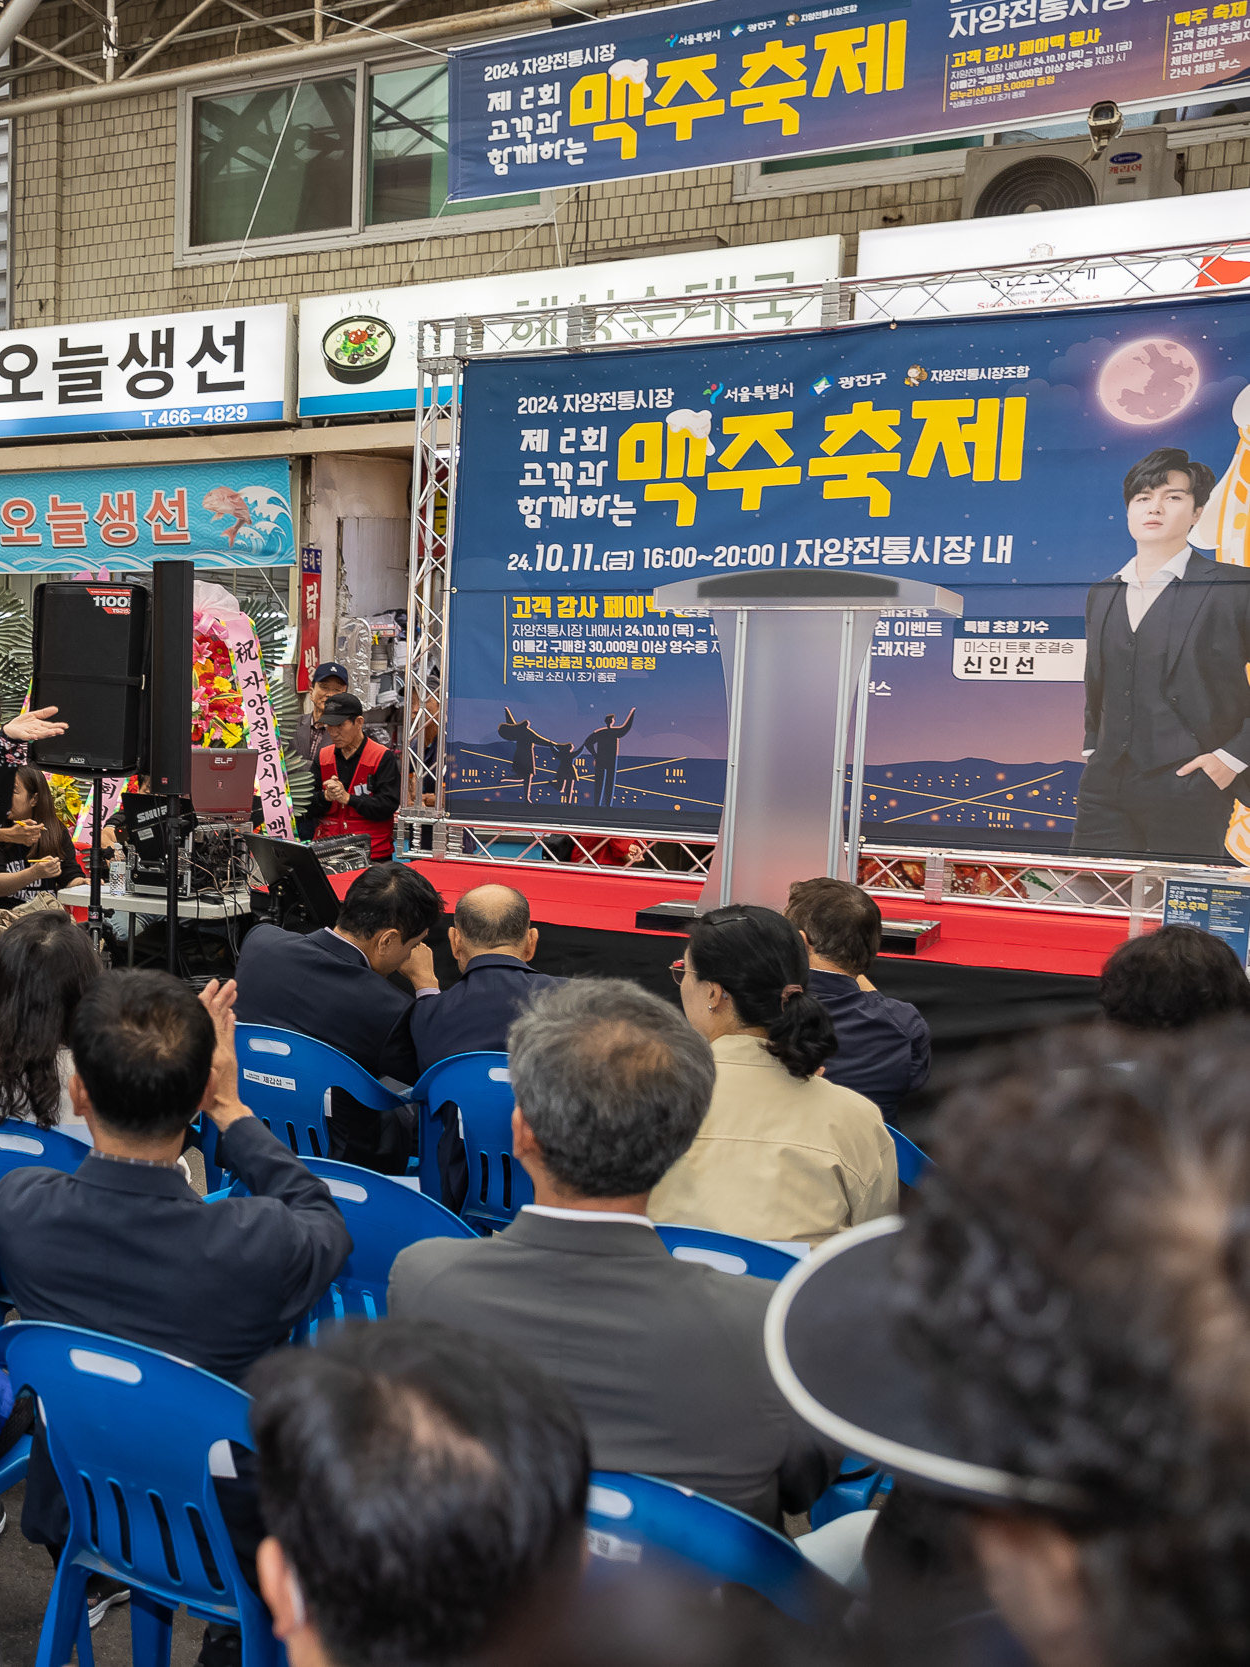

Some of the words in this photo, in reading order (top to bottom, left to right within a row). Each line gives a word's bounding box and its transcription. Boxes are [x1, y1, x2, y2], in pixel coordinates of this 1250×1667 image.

[800, 4, 857, 22] 자양전통시장조합
[1174, 8, 1208, 27] 맥주
[1213, 0, 1248, 19] 축제
[678, 29, 721, 45] 서울특별시
[747, 20, 776, 32] 광진구
[951, 49, 981, 68] 고객
[984, 43, 1016, 62] 감사
[1018, 34, 1066, 57] 페이백
[1069, 27, 1102, 47] 행사
[484, 61, 519, 81] 2024
[522, 43, 616, 75] 자양전통시장
[1170, 66, 1192, 79] 간식
[1194, 62, 1216, 75] 체험
[1218, 58, 1241, 70] 부스
[487, 90, 512, 112] 제
[520, 82, 561, 110] 2회
[488, 110, 562, 143] 고객과
[487, 137, 587, 176] 함께하는
[837, 373, 888, 389] 광진구
[930, 365, 1030, 382] 자양전통시장조합
[517, 395, 558, 414] 2024
[562, 387, 674, 413] 자양전통시장
[724, 382, 794, 402] 서울특별시
[141, 404, 248, 428] T.466-4829
[519, 429, 549, 452] 제
[559, 426, 607, 454] 2회
[518, 460, 609, 495] 고객과
[0, 487, 191, 548] 오늘생선
[517, 494, 637, 529] 함께하는
[643, 544, 774, 569] 16:00~20:00
[793, 536, 975, 567] 자양전통시장
[982, 535, 1014, 564] 내
[512, 596, 552, 618] 고객
[557, 596, 599, 618] 감사
[512, 624, 583, 638] 자양전통시장
[585, 624, 622, 638] 내에서
[625, 624, 670, 637] 24.10.10
[894, 621, 943, 637] 이벤트
[964, 621, 990, 633] 특별
[993, 621, 1020, 633] 초청
[1021, 620, 1049, 633] 가수
[234, 639, 258, 664] 祝
[512, 640, 549, 654] 이틀간
[550, 640, 586, 654] 구매한
[588, 640, 639, 654] 30,000원
[642, 641, 666, 653] 이상
[669, 640, 708, 654] 영수증
[963, 641, 1001, 653] 미스터
[1005, 641, 1031, 653] 트롯
[1034, 641, 1074, 655] 준결승
[512, 656, 583, 669] 온누리상품권
[585, 656, 628, 670] 5,000원
[631, 656, 656, 670] 증정
[545, 672, 565, 682] 소진
[566, 672, 575, 682] 시
[577, 672, 596, 682] 조기
[597, 672, 617, 683] 종료
[241, 670, 286, 809] 자양전통시장
[214, 756, 233, 765] ELF
